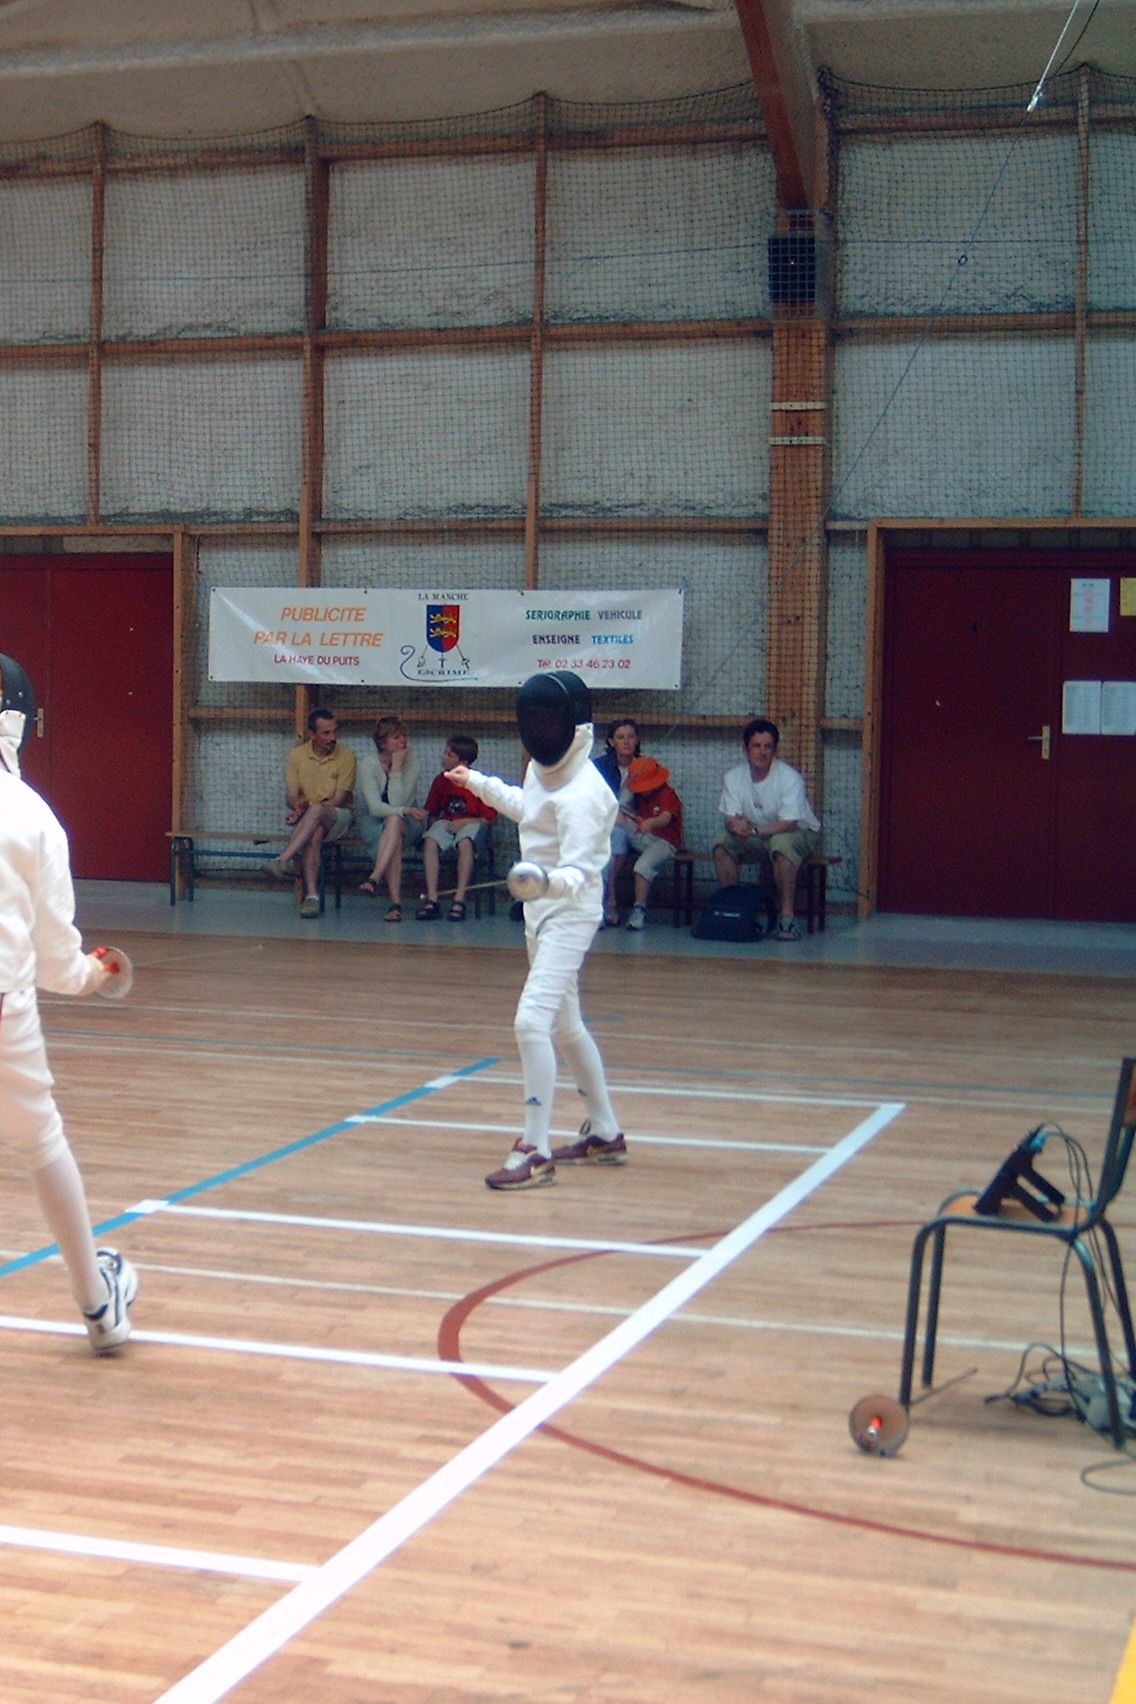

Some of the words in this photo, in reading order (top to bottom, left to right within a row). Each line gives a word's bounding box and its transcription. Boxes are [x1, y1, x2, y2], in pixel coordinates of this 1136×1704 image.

[280, 607, 366, 621] PUBLICITE
[525, 609, 591, 620] SERIGRAPHIE
[597, 609, 643, 620] VEHICULE
[253, 630, 287, 645] PAR
[291, 631, 312, 646] LA
[319, 632, 384, 647] LETTRE
[532, 634, 580, 645] ENSEIGNE
[591, 634, 634, 645] TEXTILES
[274, 654, 287, 664] LA
[288, 655, 314, 665] HAYE
[316, 655, 331, 665] DU
[332, 656, 361, 666] PUITS
